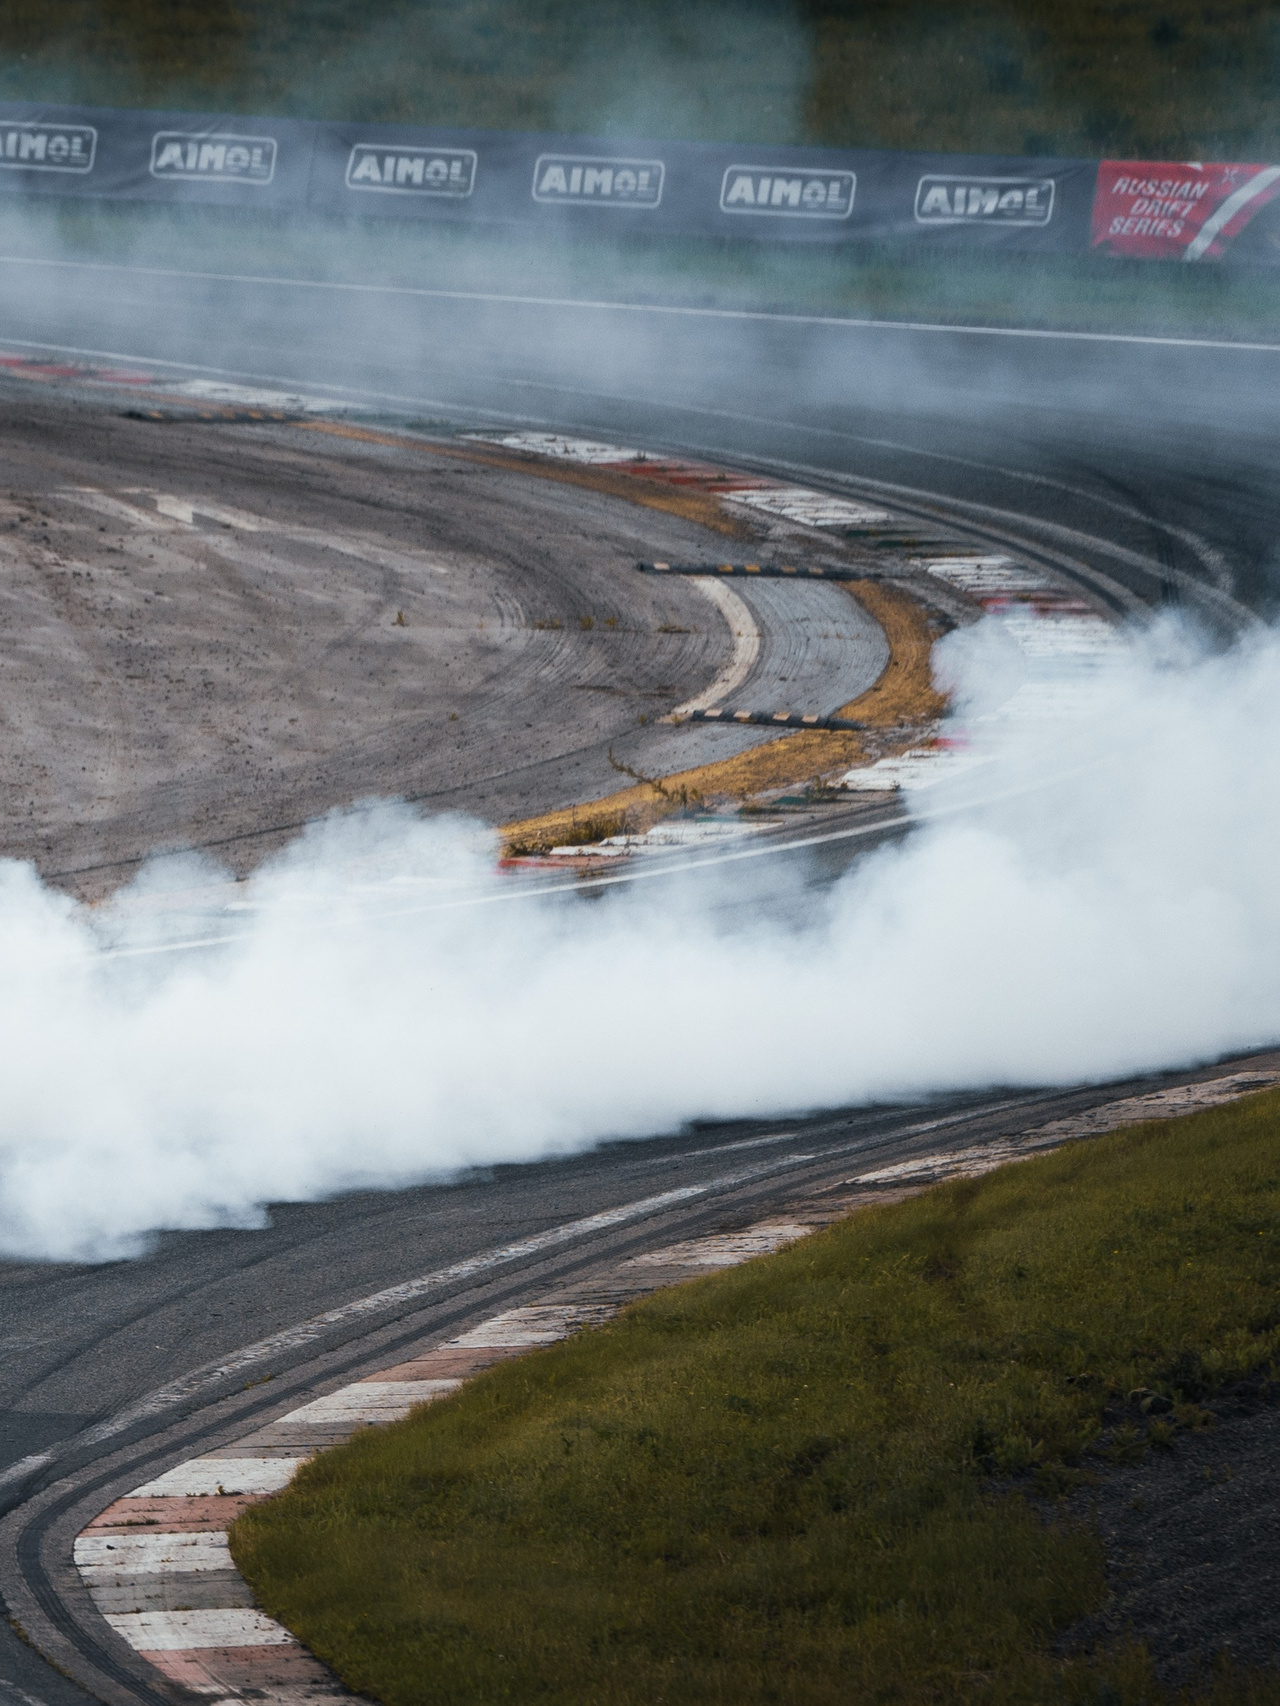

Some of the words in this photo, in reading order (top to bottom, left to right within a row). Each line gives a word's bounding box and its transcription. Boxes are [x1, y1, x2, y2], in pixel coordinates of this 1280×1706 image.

[156, 140, 269, 171] AIMOL
[352, 155, 467, 184] AIMOL
[538, 166, 656, 197] AIMOL
[726, 176, 848, 208] AIMOL
[1112, 176, 1210, 200] RUSSIAN
[920, 185, 1046, 217] AIMOL
[1130, 197, 1197, 218] DRIFT
[1108, 216, 1186, 238] SERIES
